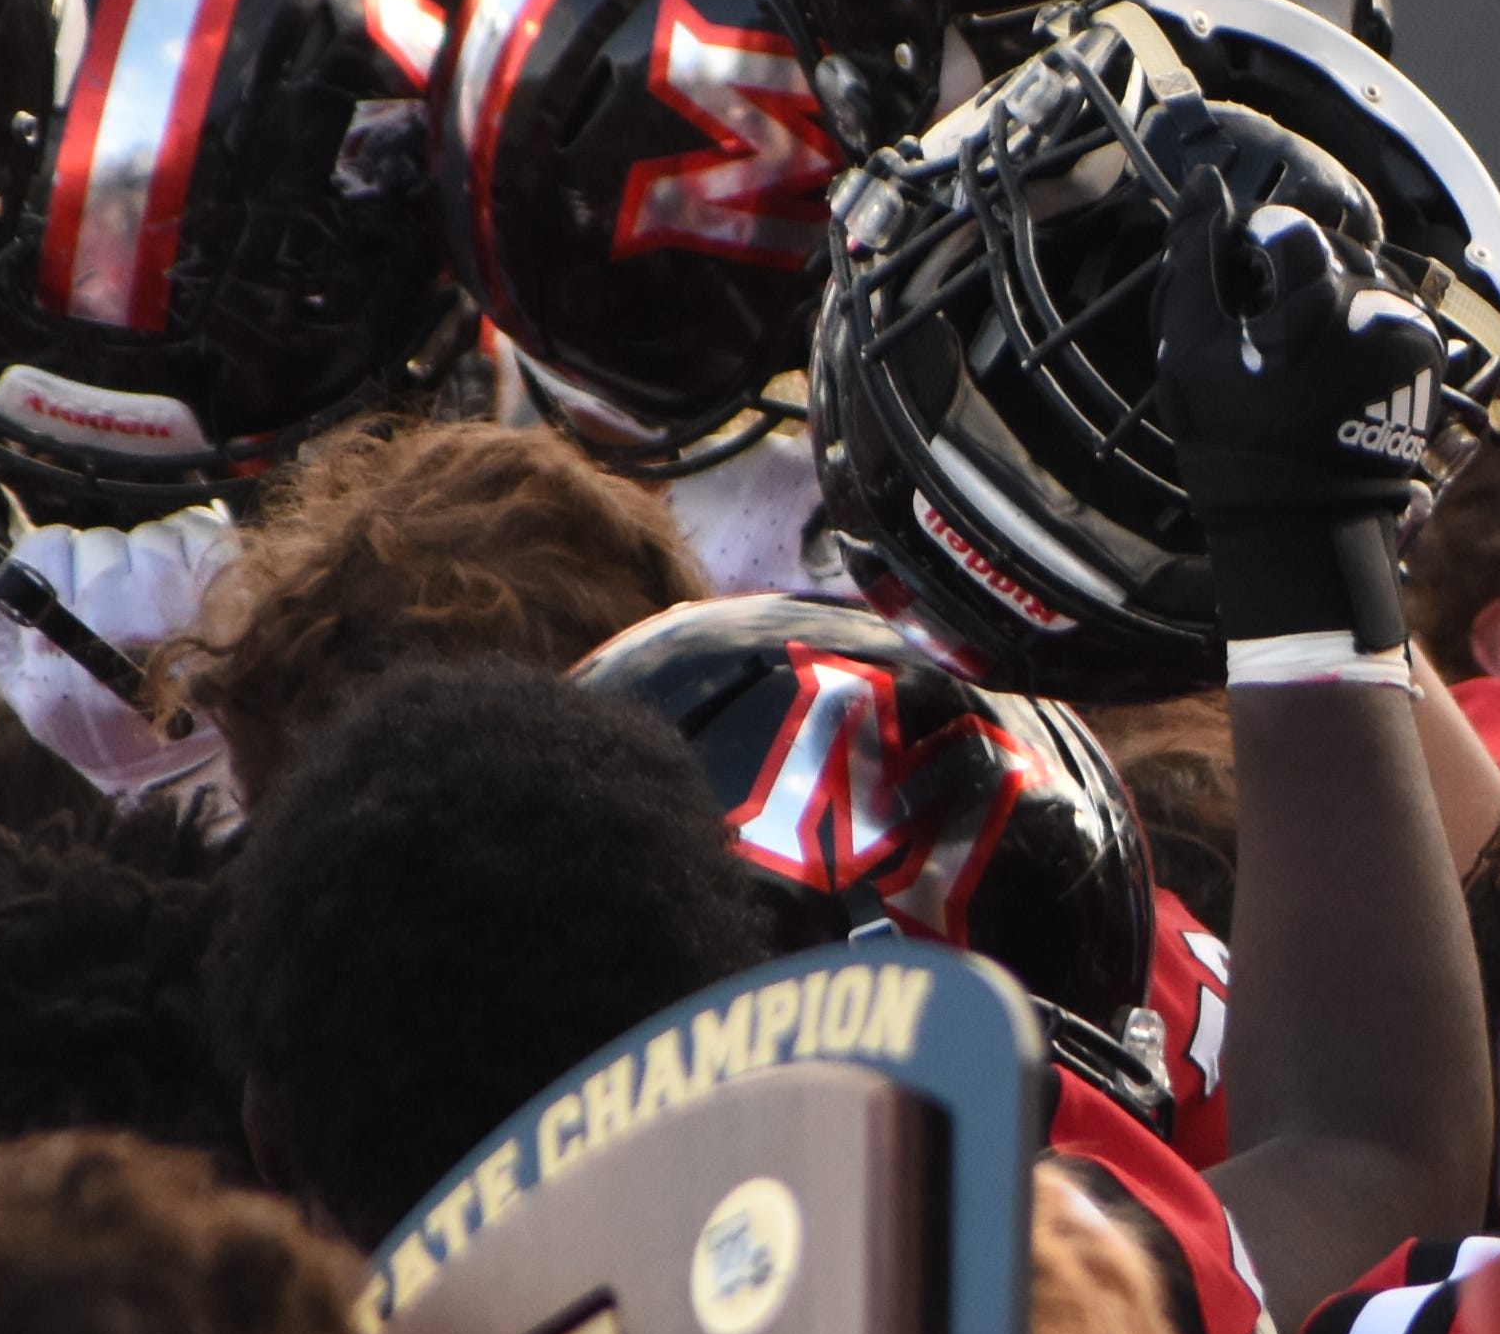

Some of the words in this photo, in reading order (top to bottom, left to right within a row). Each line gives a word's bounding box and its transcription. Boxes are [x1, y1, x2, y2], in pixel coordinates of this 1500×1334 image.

[1336, 418, 1427, 464] adidas
[924, 504, 1058, 625] Riddell
[536, 962, 934, 1182] CHAMPION
